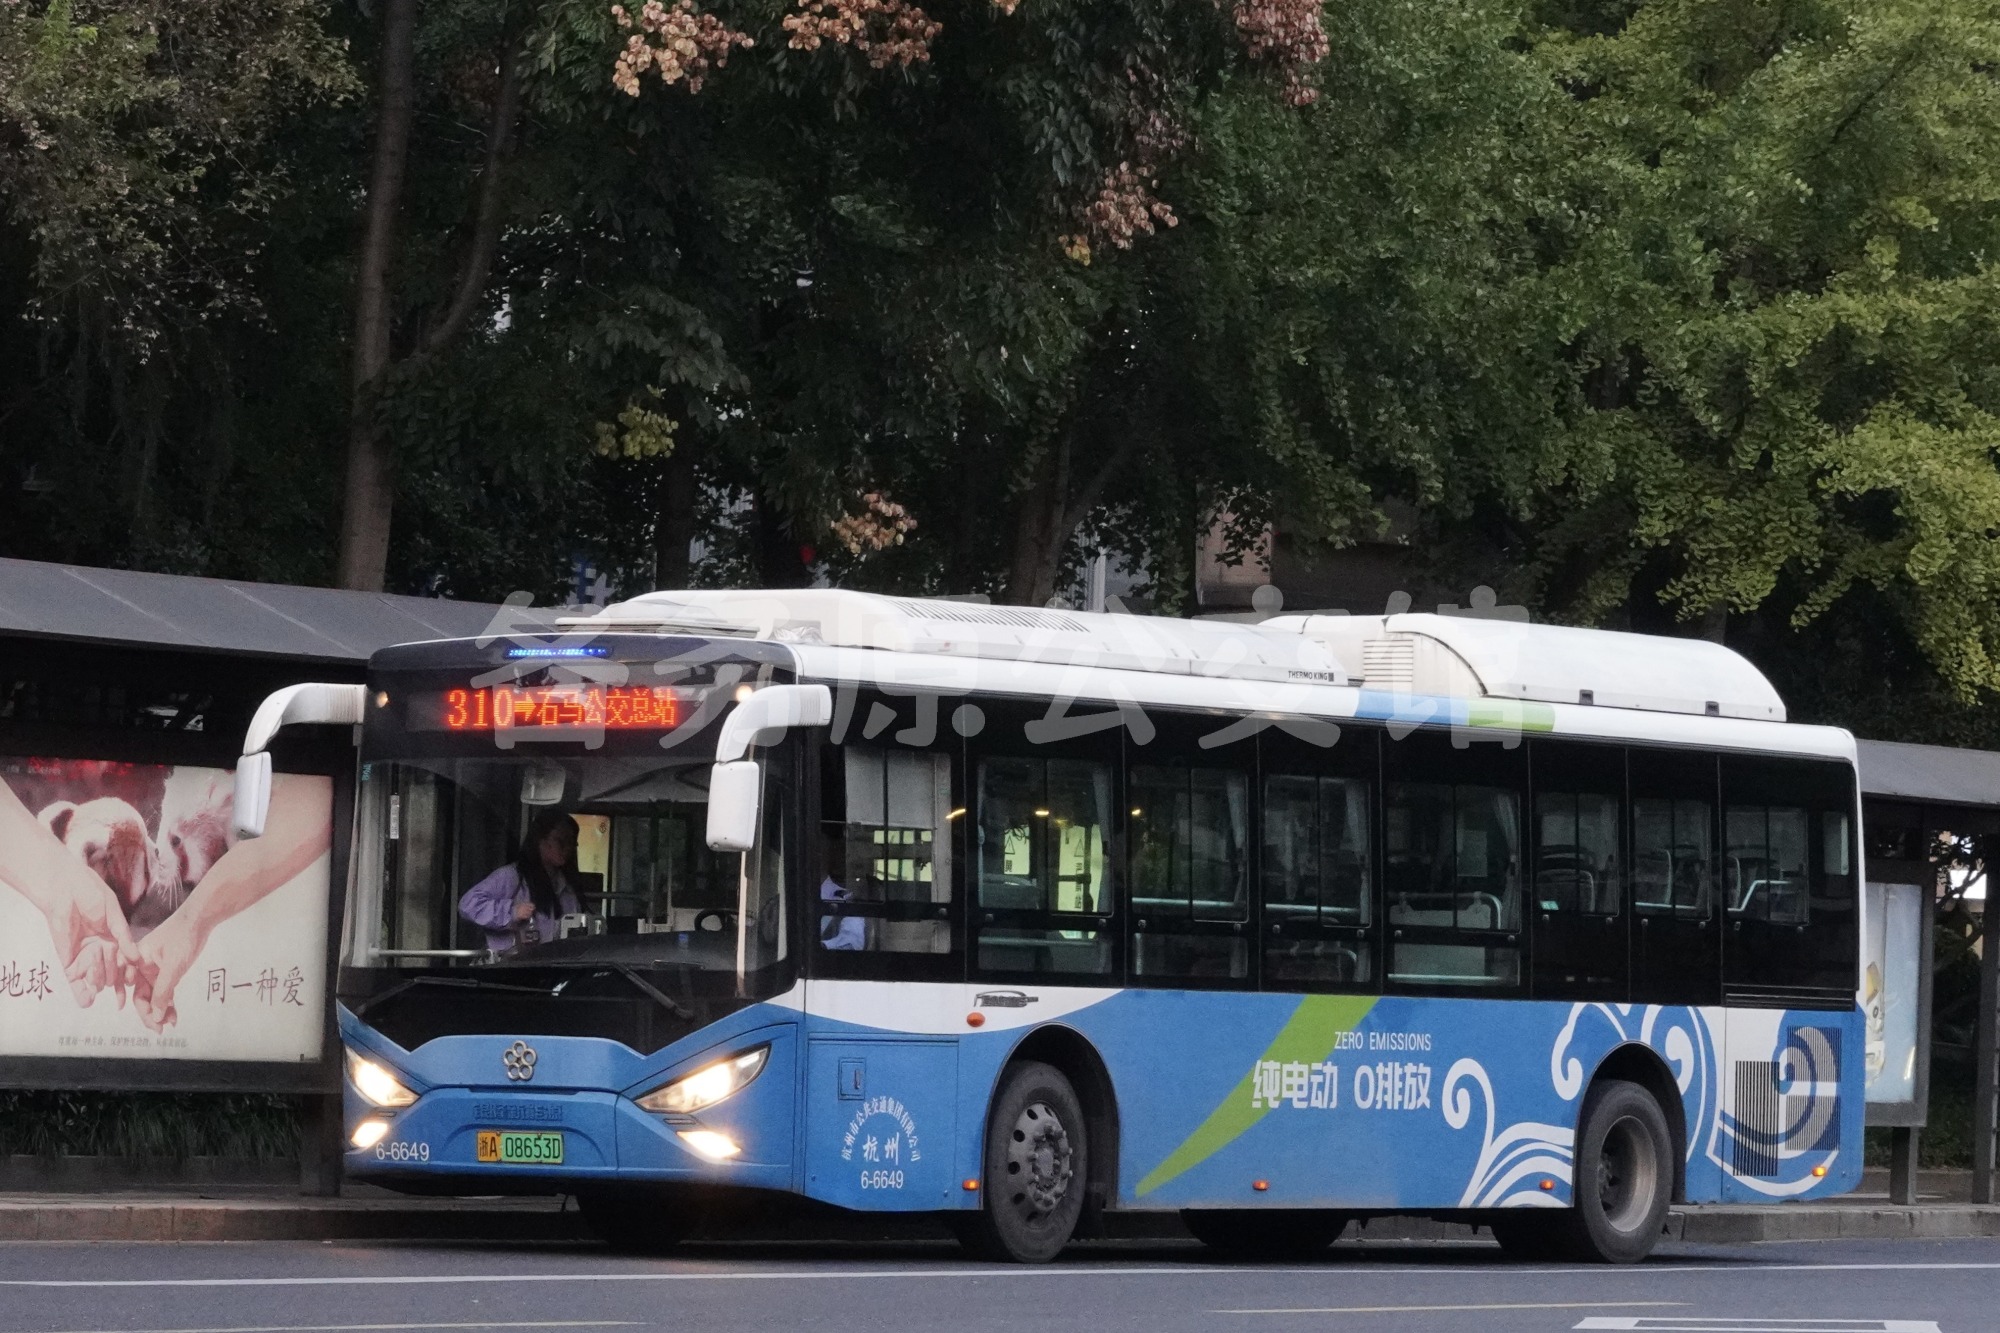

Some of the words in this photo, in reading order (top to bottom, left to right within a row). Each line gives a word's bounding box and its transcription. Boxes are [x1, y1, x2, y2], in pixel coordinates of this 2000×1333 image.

[1288, 670, 1313, 680] THERMO
[1314, 671, 1328, 681] KING
[447, 688, 514, 727] 310
[536, 687, 678, 727] 石马公交总站
[0, 961, 53, 1001] 地球
[207, 966, 304, 1006] 同一种爱
[1334, 1031, 1363, 1050] ZERO
[1370, 1032, 1432, 1051] EMISSIONS
[1252, 1060, 1338, 1109] 纯电动
[1354, 1061, 1431, 1110] 0排放
[375, 1142, 430, 1162] 6-6649
[862, 1132, 900, 1166] 杭州
[860, 1170, 904, 1189] 6-6649
